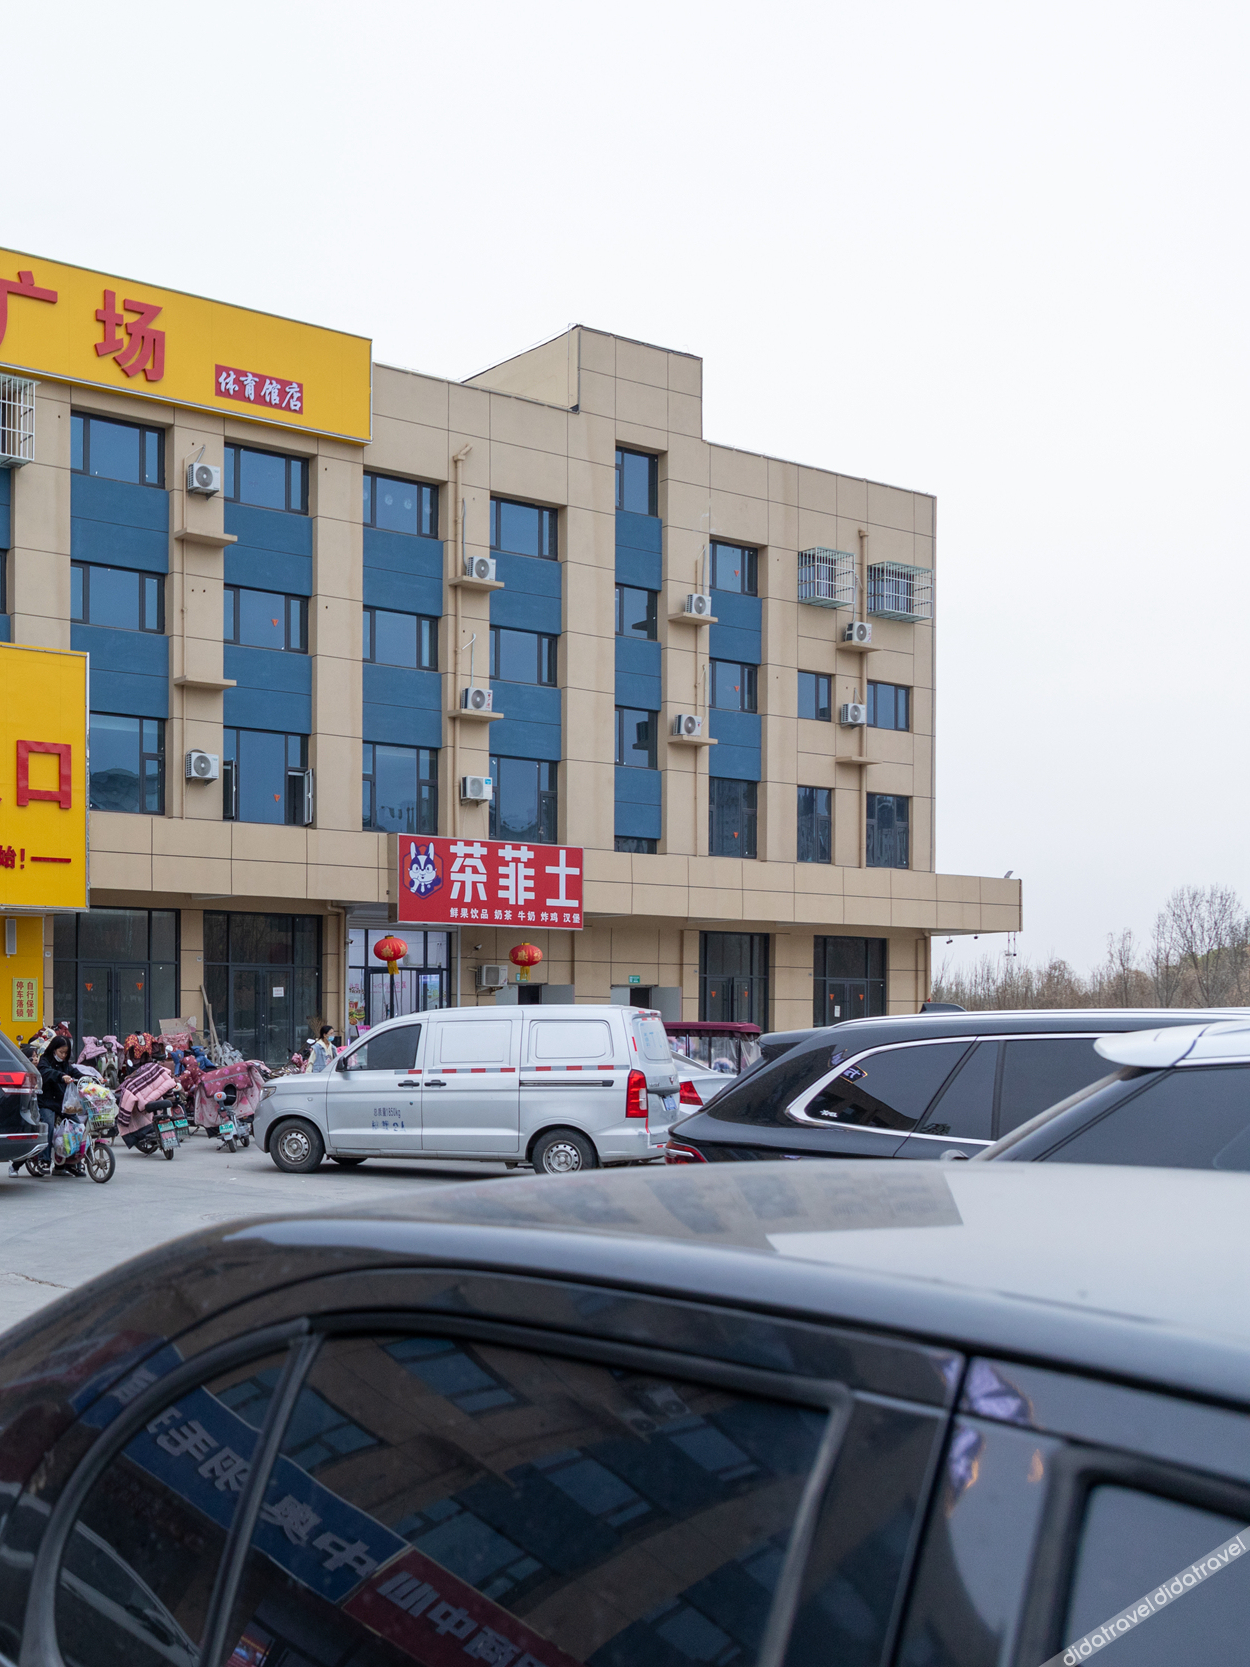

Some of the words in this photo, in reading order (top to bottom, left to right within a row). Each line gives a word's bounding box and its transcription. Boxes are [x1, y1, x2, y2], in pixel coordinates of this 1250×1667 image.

[218, 370, 302, 411] 体育馆店
[449, 840, 581, 908] 茶菲士
[449, 907, 489, 920] 鲜果饮品
[494, 909, 513, 921] 奶茶
[517, 910, 536, 922] 牛奶
[540, 911, 559, 923] 炸鸡
[563, 912, 581, 924] 汉堡
[16, 981, 24, 1018] 停车落锁
[26, 981, 34, 1018] 自行保管
